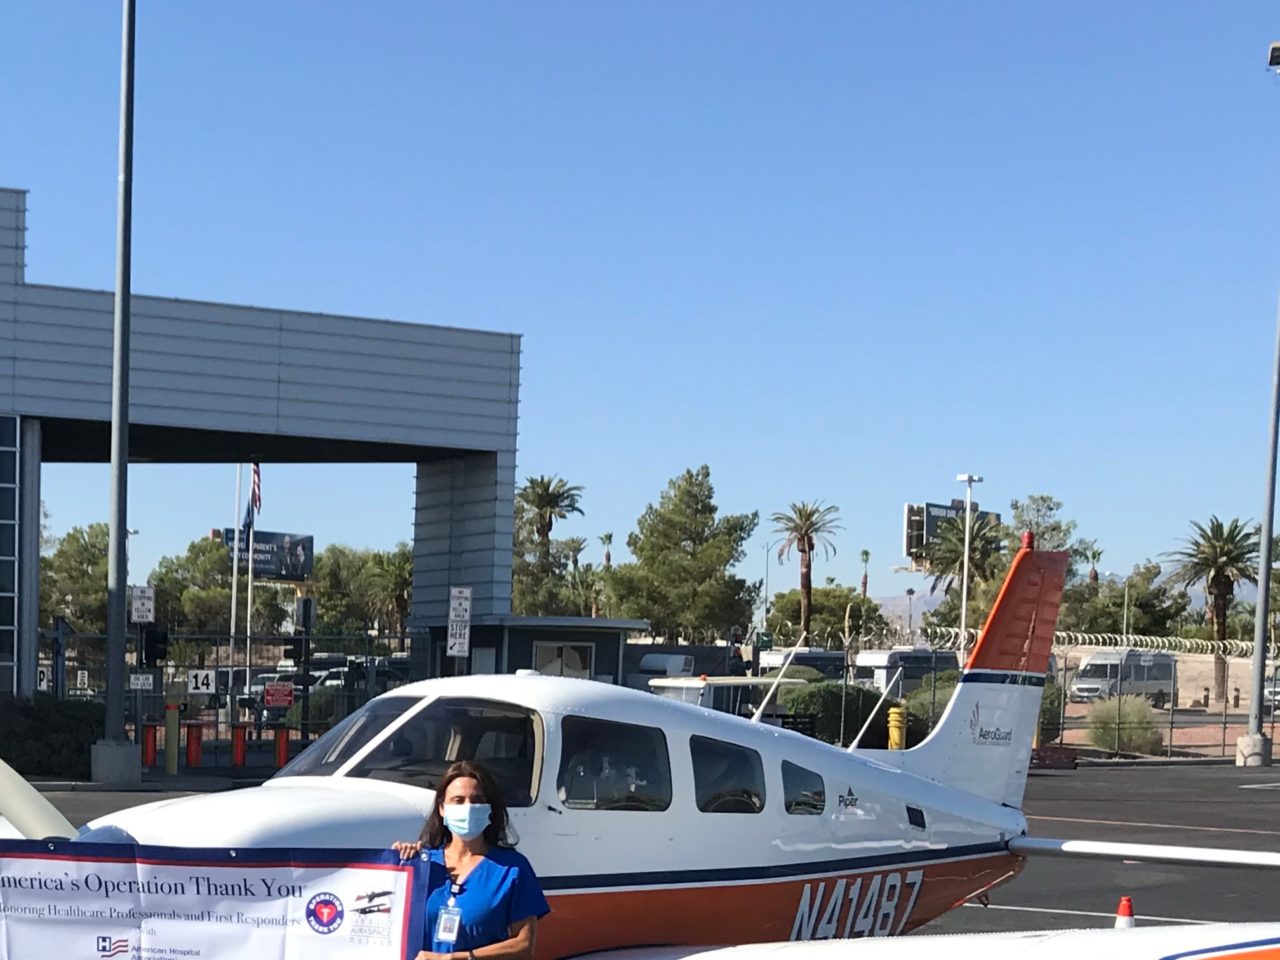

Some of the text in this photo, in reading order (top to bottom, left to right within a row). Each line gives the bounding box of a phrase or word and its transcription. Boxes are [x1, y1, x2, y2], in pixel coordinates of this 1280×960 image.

[192, 672, 211, 691] 14
[978, 727, 1012, 741] AeroGuard
[838, 794, 859, 809] Piper
[84, 873, 185, 898] Operation
[189, 876, 256, 897] Thank
[260, 878, 303, 898] You
[789, 869, 924, 942] N41487
[48, 904, 106, 918] Healthcare
[109, 907, 182, 920] Professionals
[184, 911, 205, 922] and
[207, 912, 234, 923] First
[236, 912, 302, 928] Responders
[169, 947, 200, 957] Hospital
